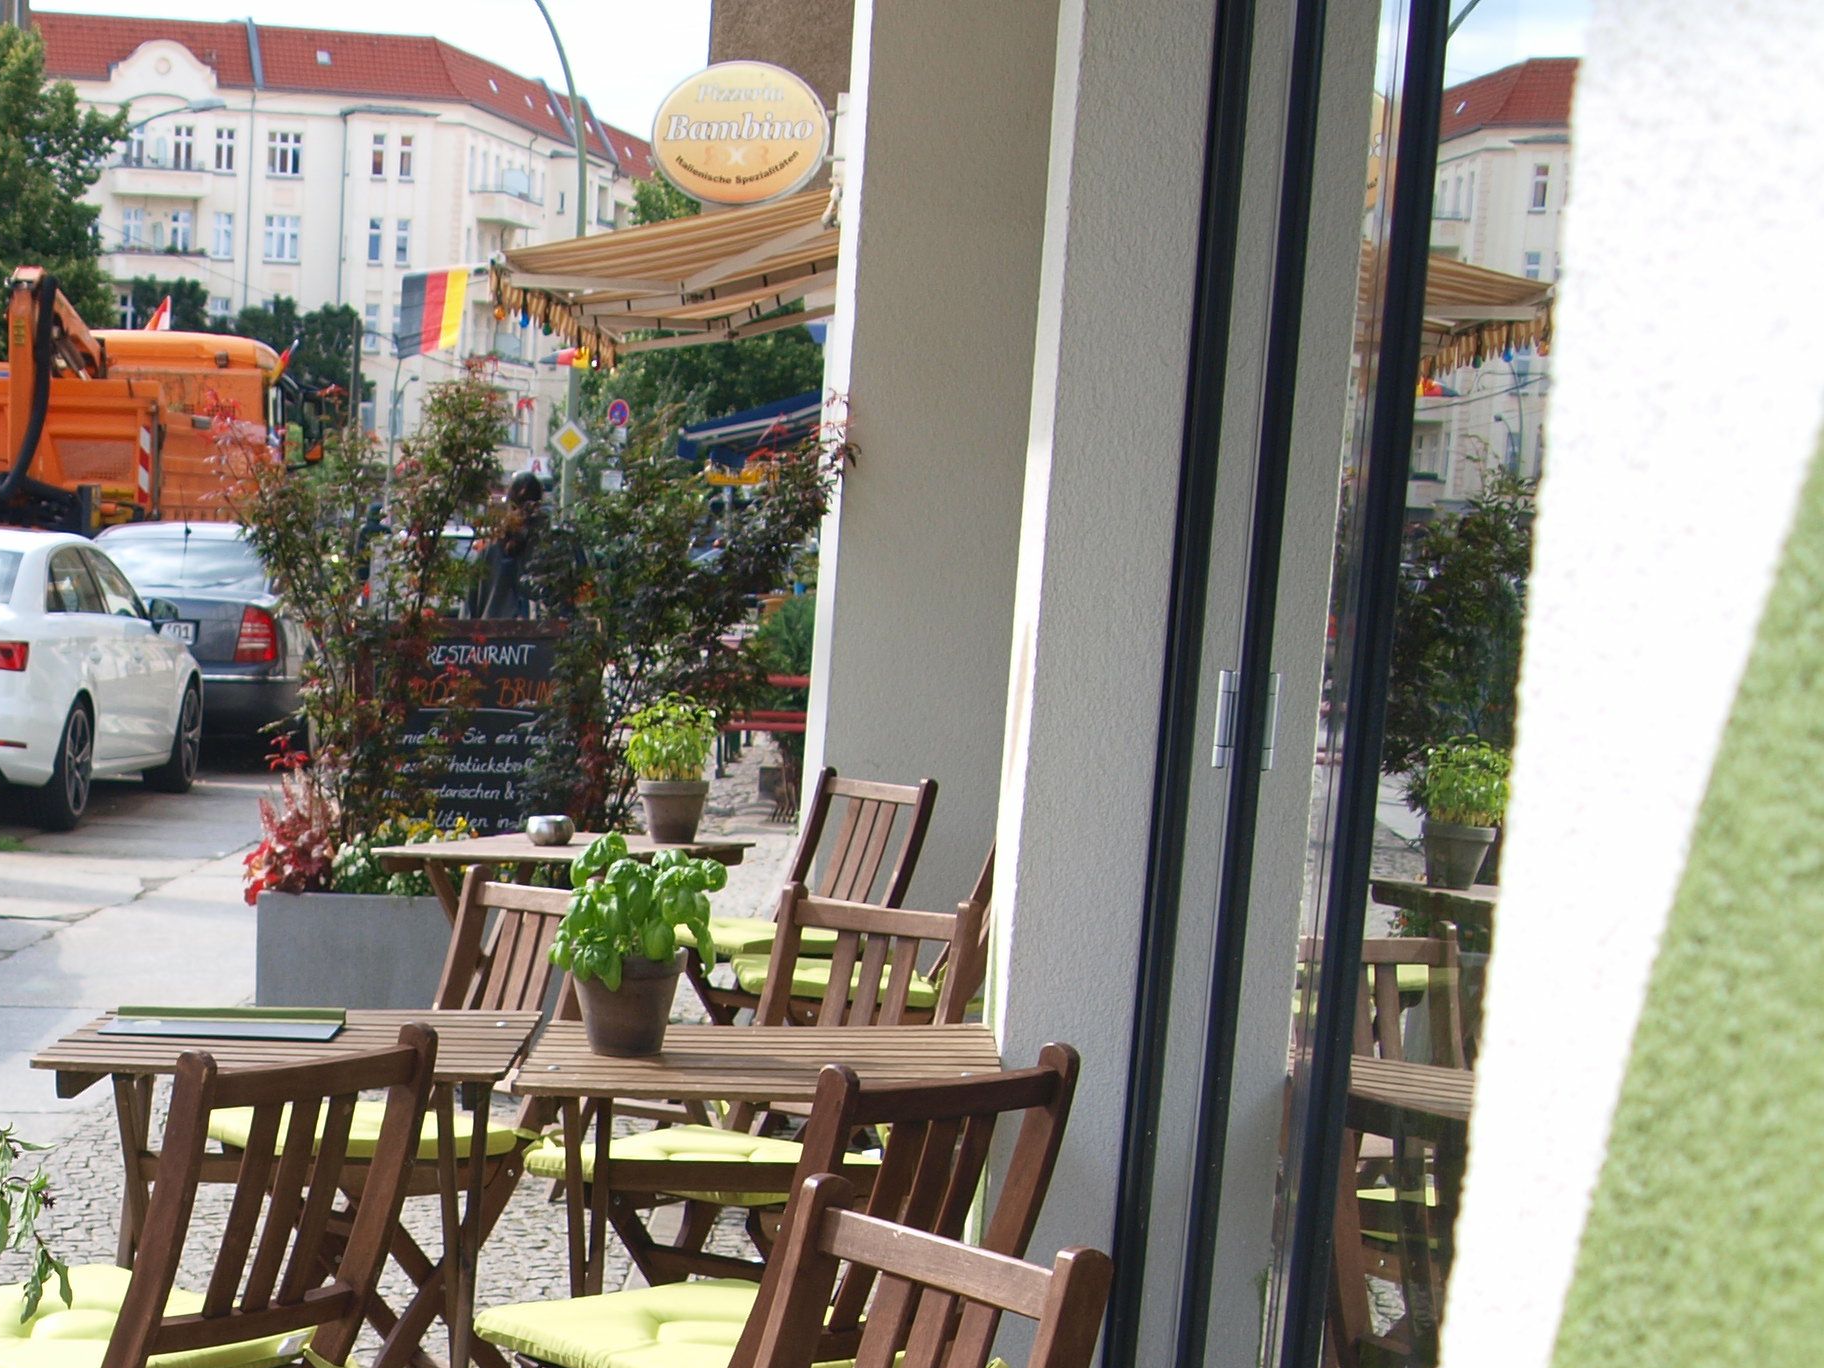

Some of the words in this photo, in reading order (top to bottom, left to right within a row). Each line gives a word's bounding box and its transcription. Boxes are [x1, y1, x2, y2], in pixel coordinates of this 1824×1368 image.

[696, 82, 784, 103] Pizzeria
[664, 111, 814, 141] Bambino
[675, 155, 732, 184] Italienische
[426, 644, 537, 666] RESTAURANT
[462, 727, 487, 745] Sie
[495, 729, 518, 744] ein
